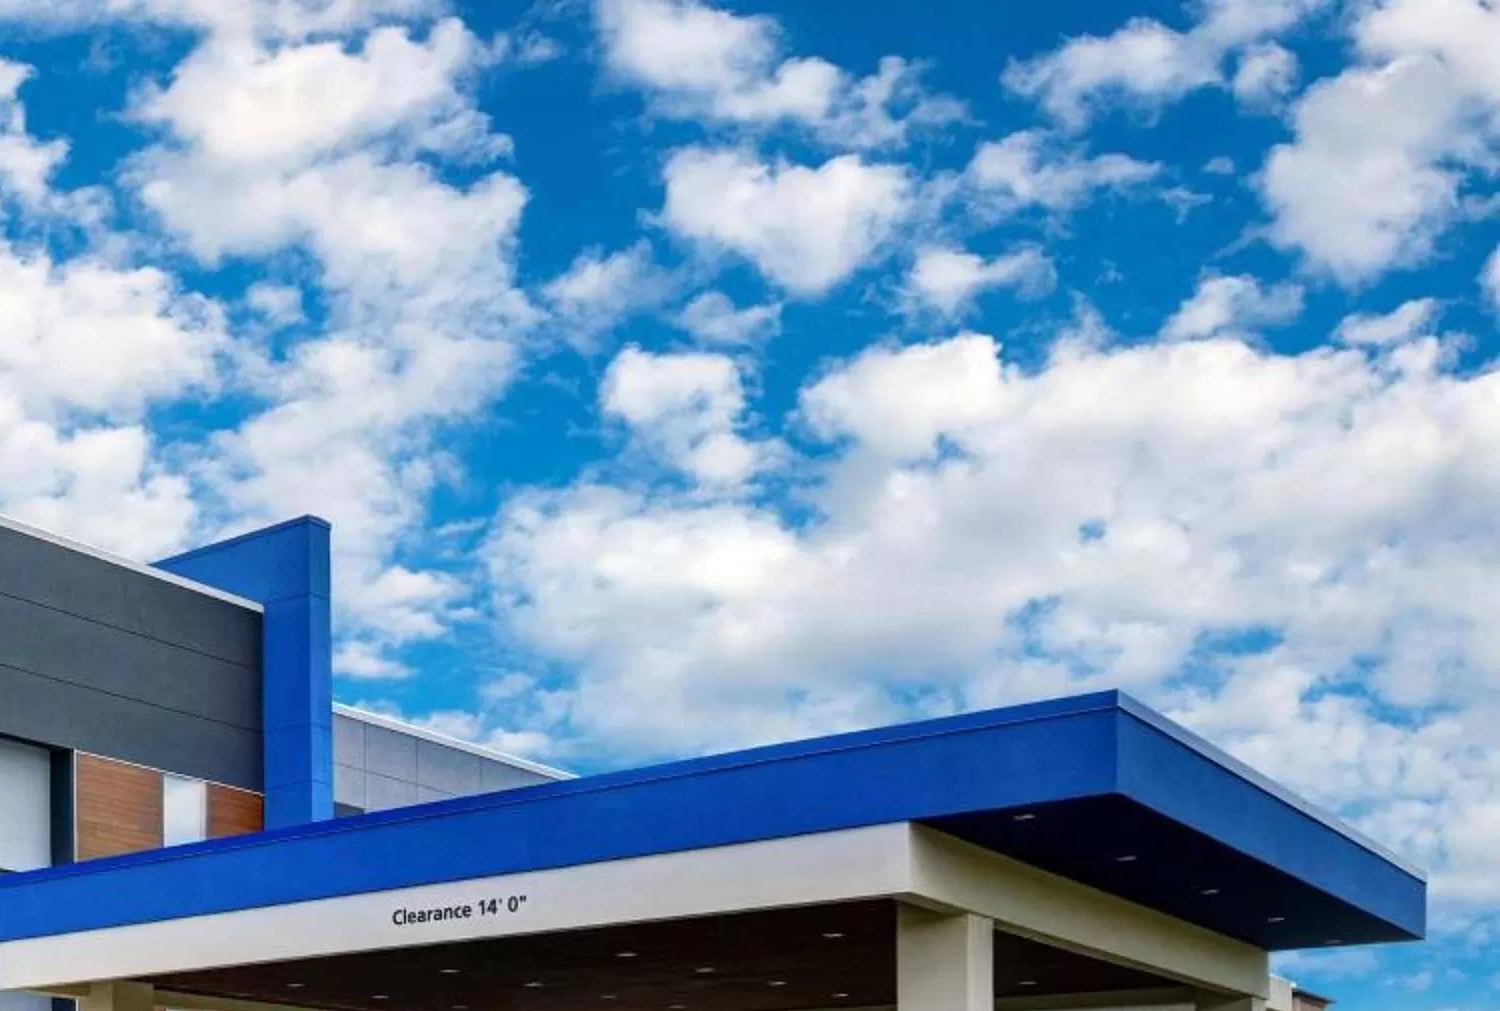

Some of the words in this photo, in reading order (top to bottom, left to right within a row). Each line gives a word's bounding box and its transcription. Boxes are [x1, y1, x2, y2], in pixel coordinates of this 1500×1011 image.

[391, 904, 473, 926] Clearance
[477, 898, 503, 916] 14'
[507, 895, 527, 913] 0"
